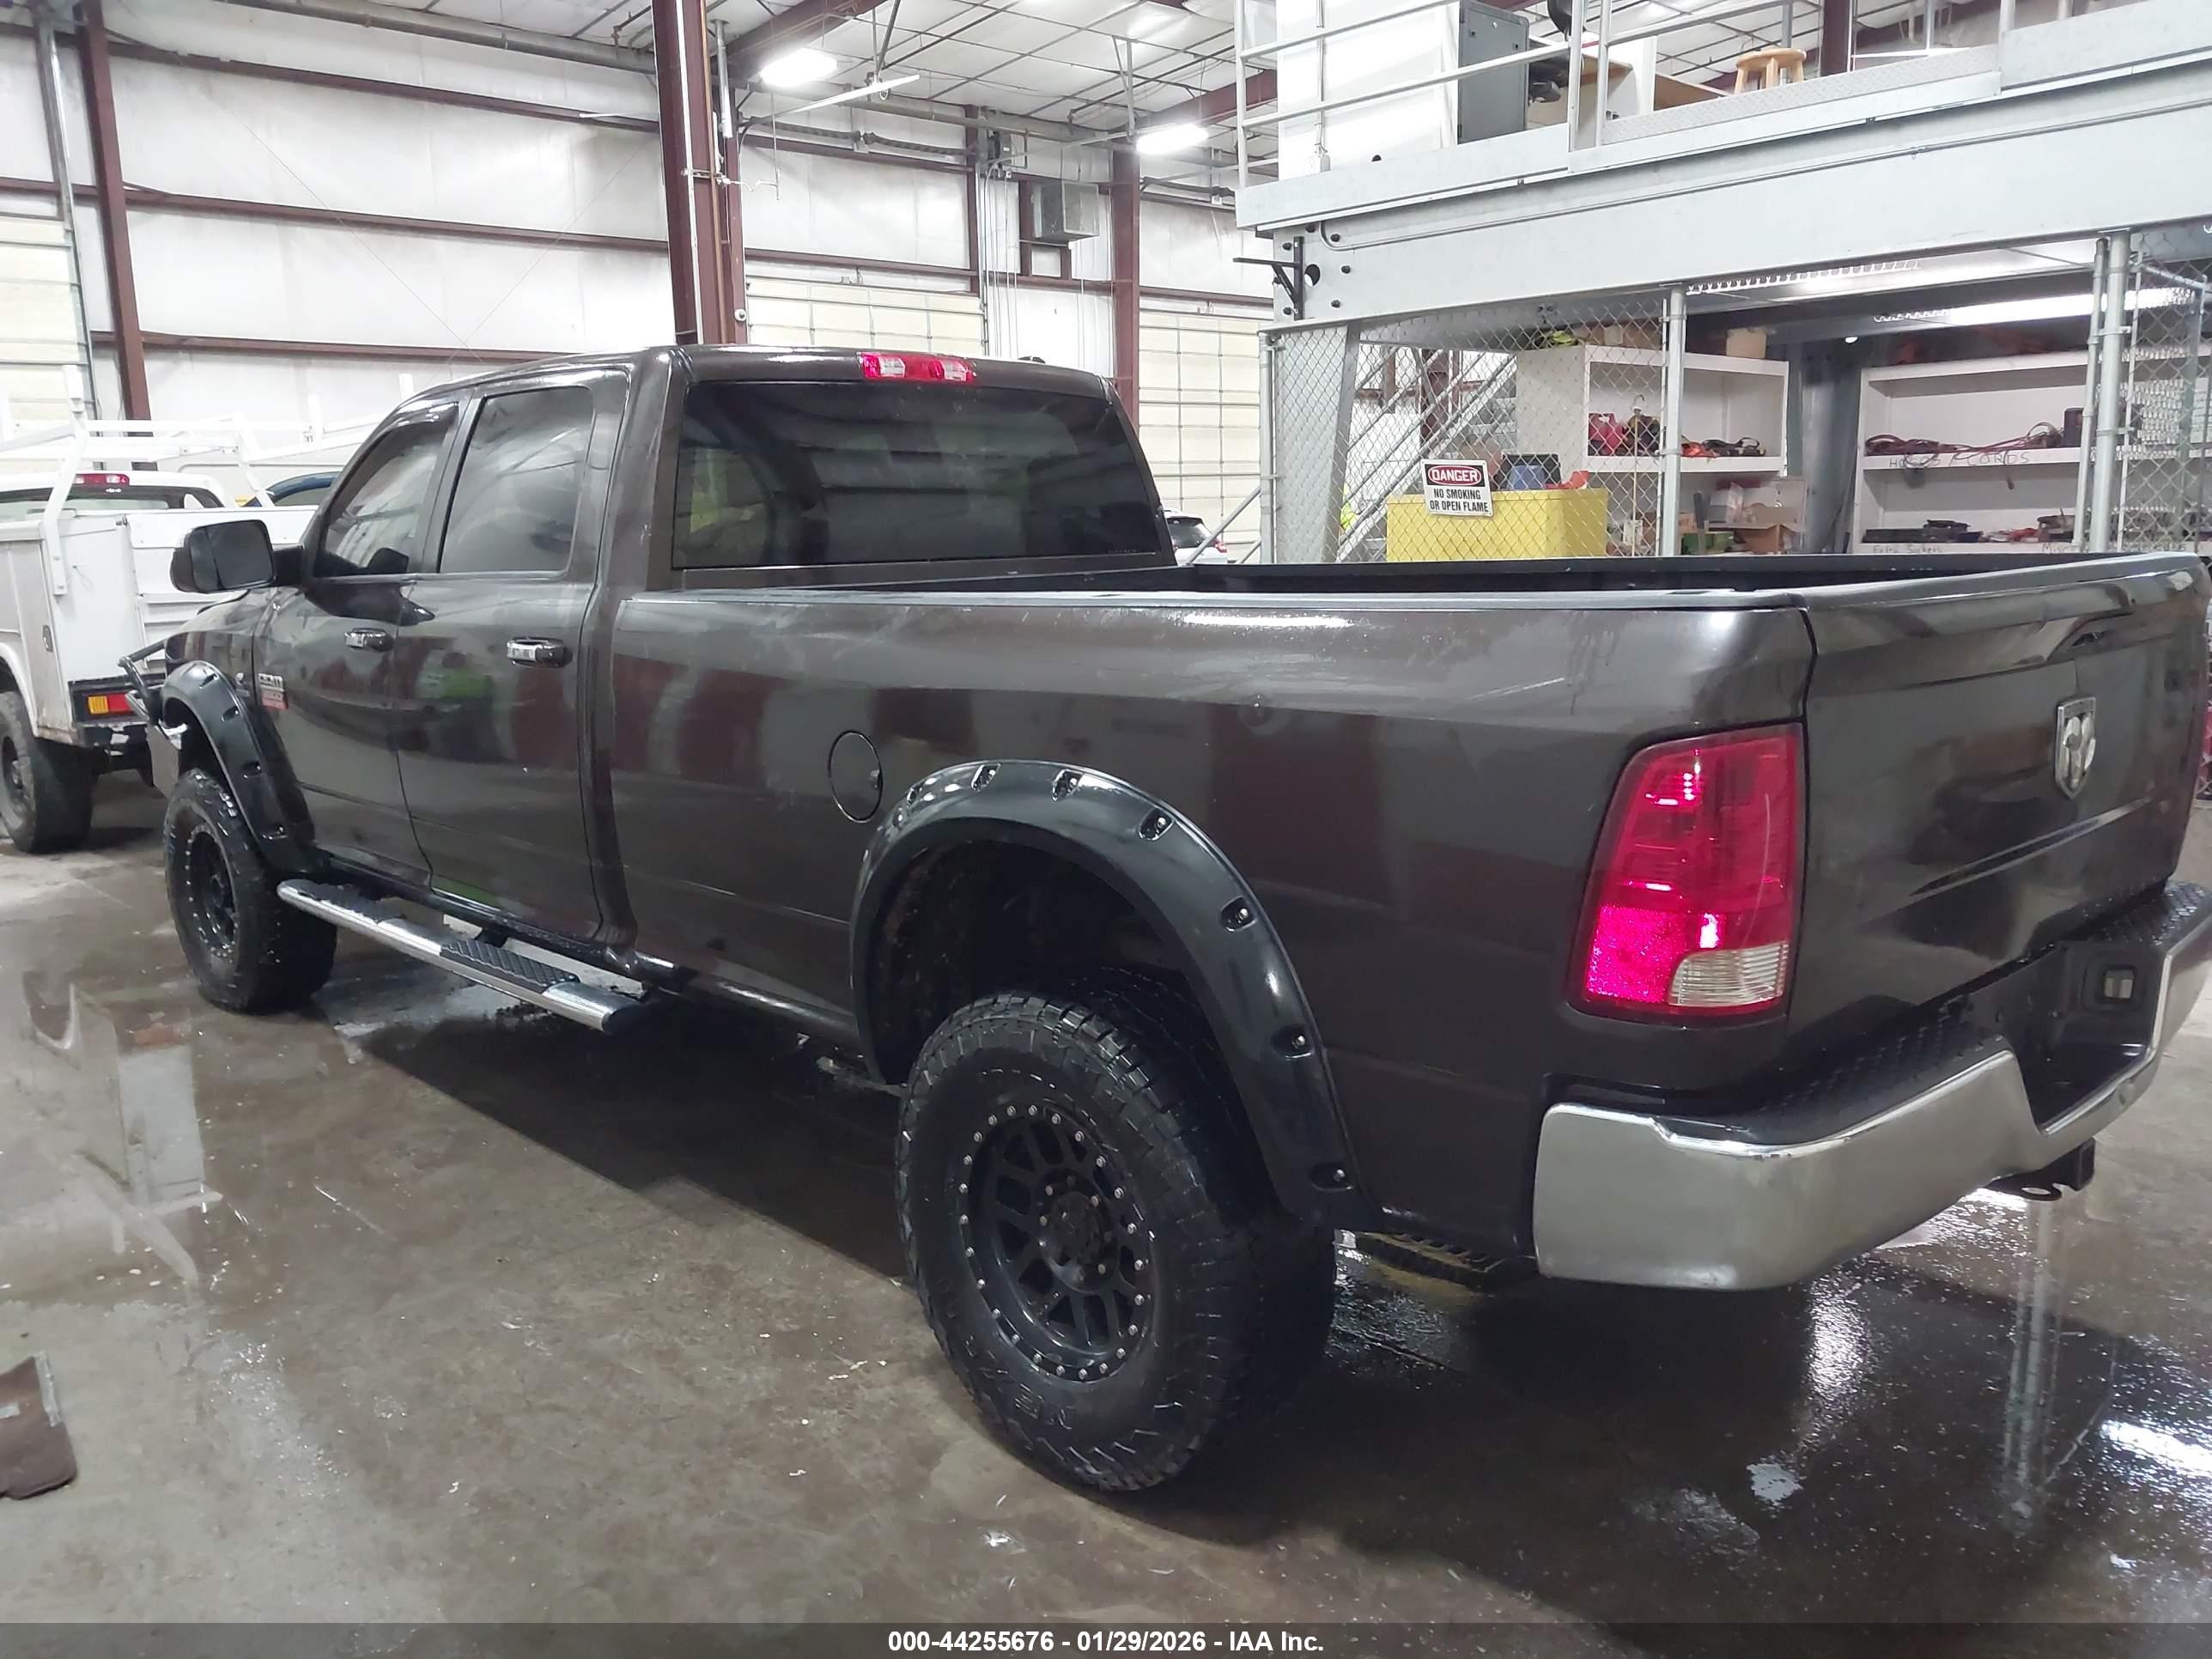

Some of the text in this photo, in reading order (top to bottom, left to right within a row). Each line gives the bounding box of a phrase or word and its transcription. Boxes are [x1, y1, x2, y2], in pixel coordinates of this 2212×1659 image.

[1431, 469, 1478, 481] DANGER
[1434, 489, 1480, 500] NO SMOKING
[1430, 500, 1489, 513] OR OPEN FLAME
